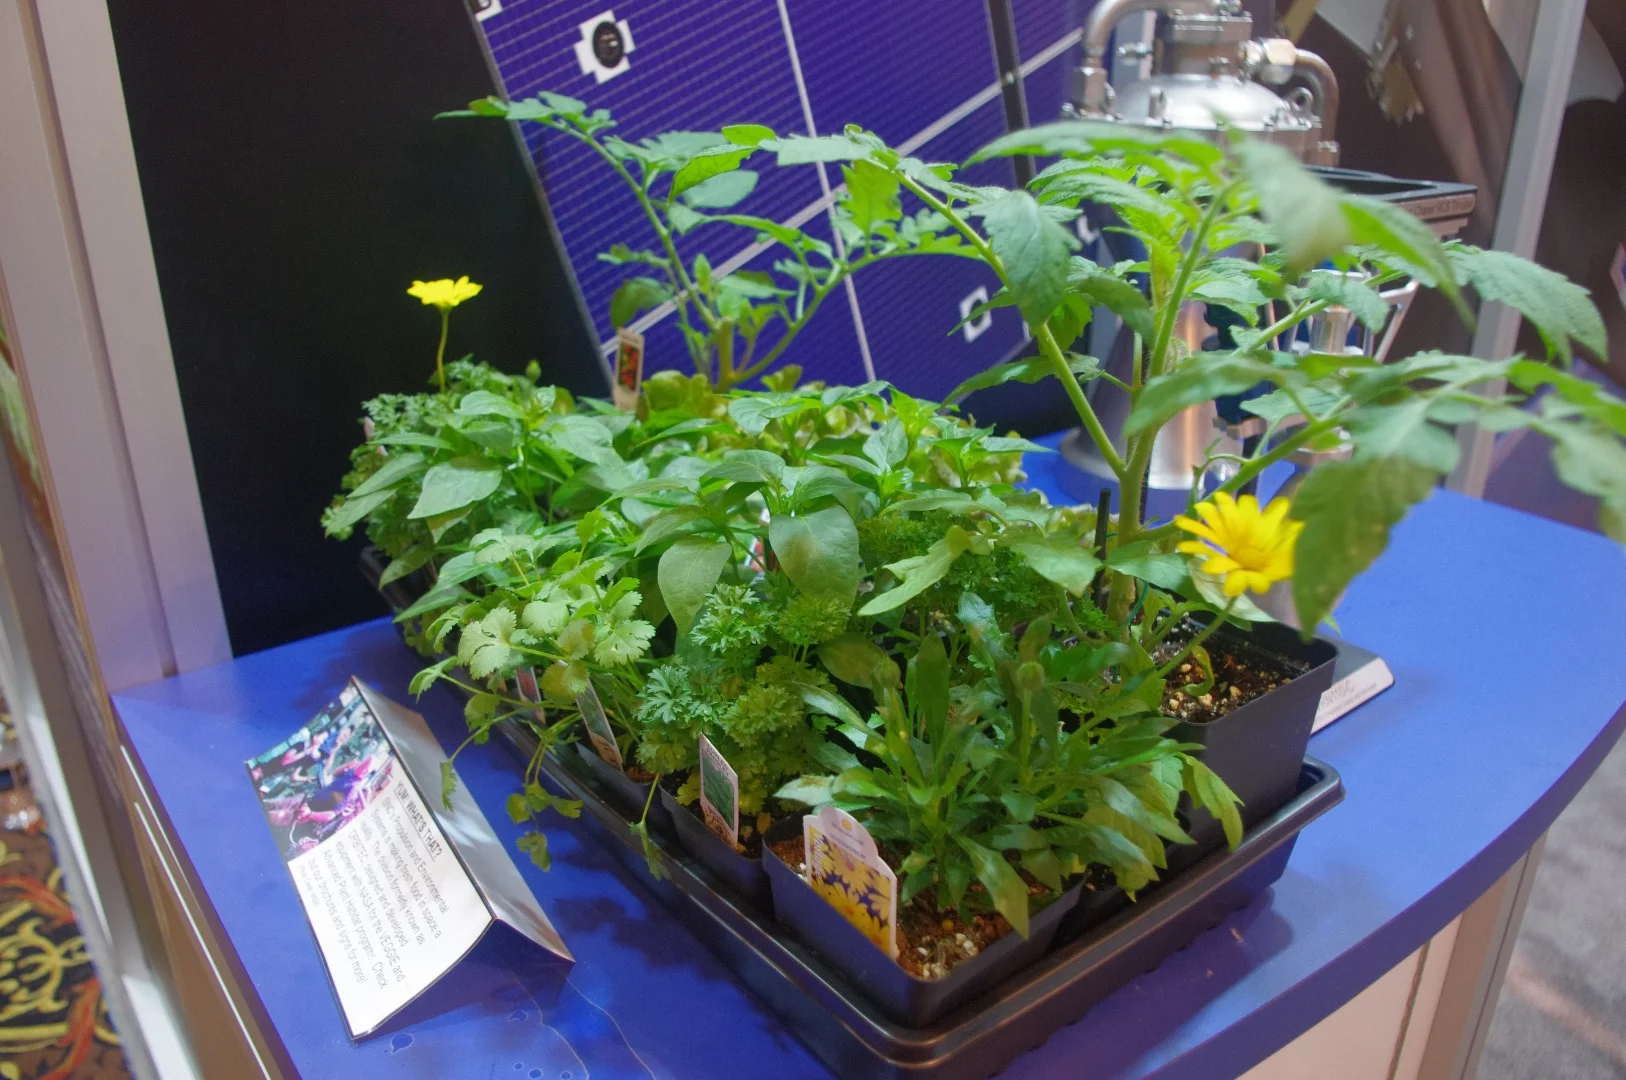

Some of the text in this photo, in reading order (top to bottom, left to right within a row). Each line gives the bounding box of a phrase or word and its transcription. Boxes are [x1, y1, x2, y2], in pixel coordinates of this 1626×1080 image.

[395, 780, 442, 858] YUM! WHAT'S THAT?
[308, 857, 319, 871] out
[318, 879, 337, 916] brochures
[371, 808, 387, 837] Systems
[388, 842, 403, 868] making
[400, 863, 413, 885] fresh
[409, 880, 423, 901] food
[418, 898, 425, 909] in
[422, 907, 437, 932] space
[434, 930, 442, 939] a
[371, 839, 381, 857] The
[377, 855, 393, 882] division
[389, 878, 406, 910] formerly
[404, 907, 420, 934] known
[416, 933, 424, 945] as
[392, 815, 413, 851] Propulsion
[409, 848, 423, 865] and
[417, 861, 449, 914] Environmental
[323, 849, 343, 883] Advanced
[337, 880, 351, 901] Plant
[344, 898, 362, 927] Habitat
[371, 960, 389, 989] Check
[332, 914, 345, 930] and
[334, 840, 406, 982] equipment with NASA for the VEGGIE and
[338, 929, 352, 951] signs
[363, 863, 383, 895] designed
[378, 893, 390, 909] and
[385, 907, 409, 947] developed
[346, 947, 357, 962] for
[351, 960, 368, 984] more!
